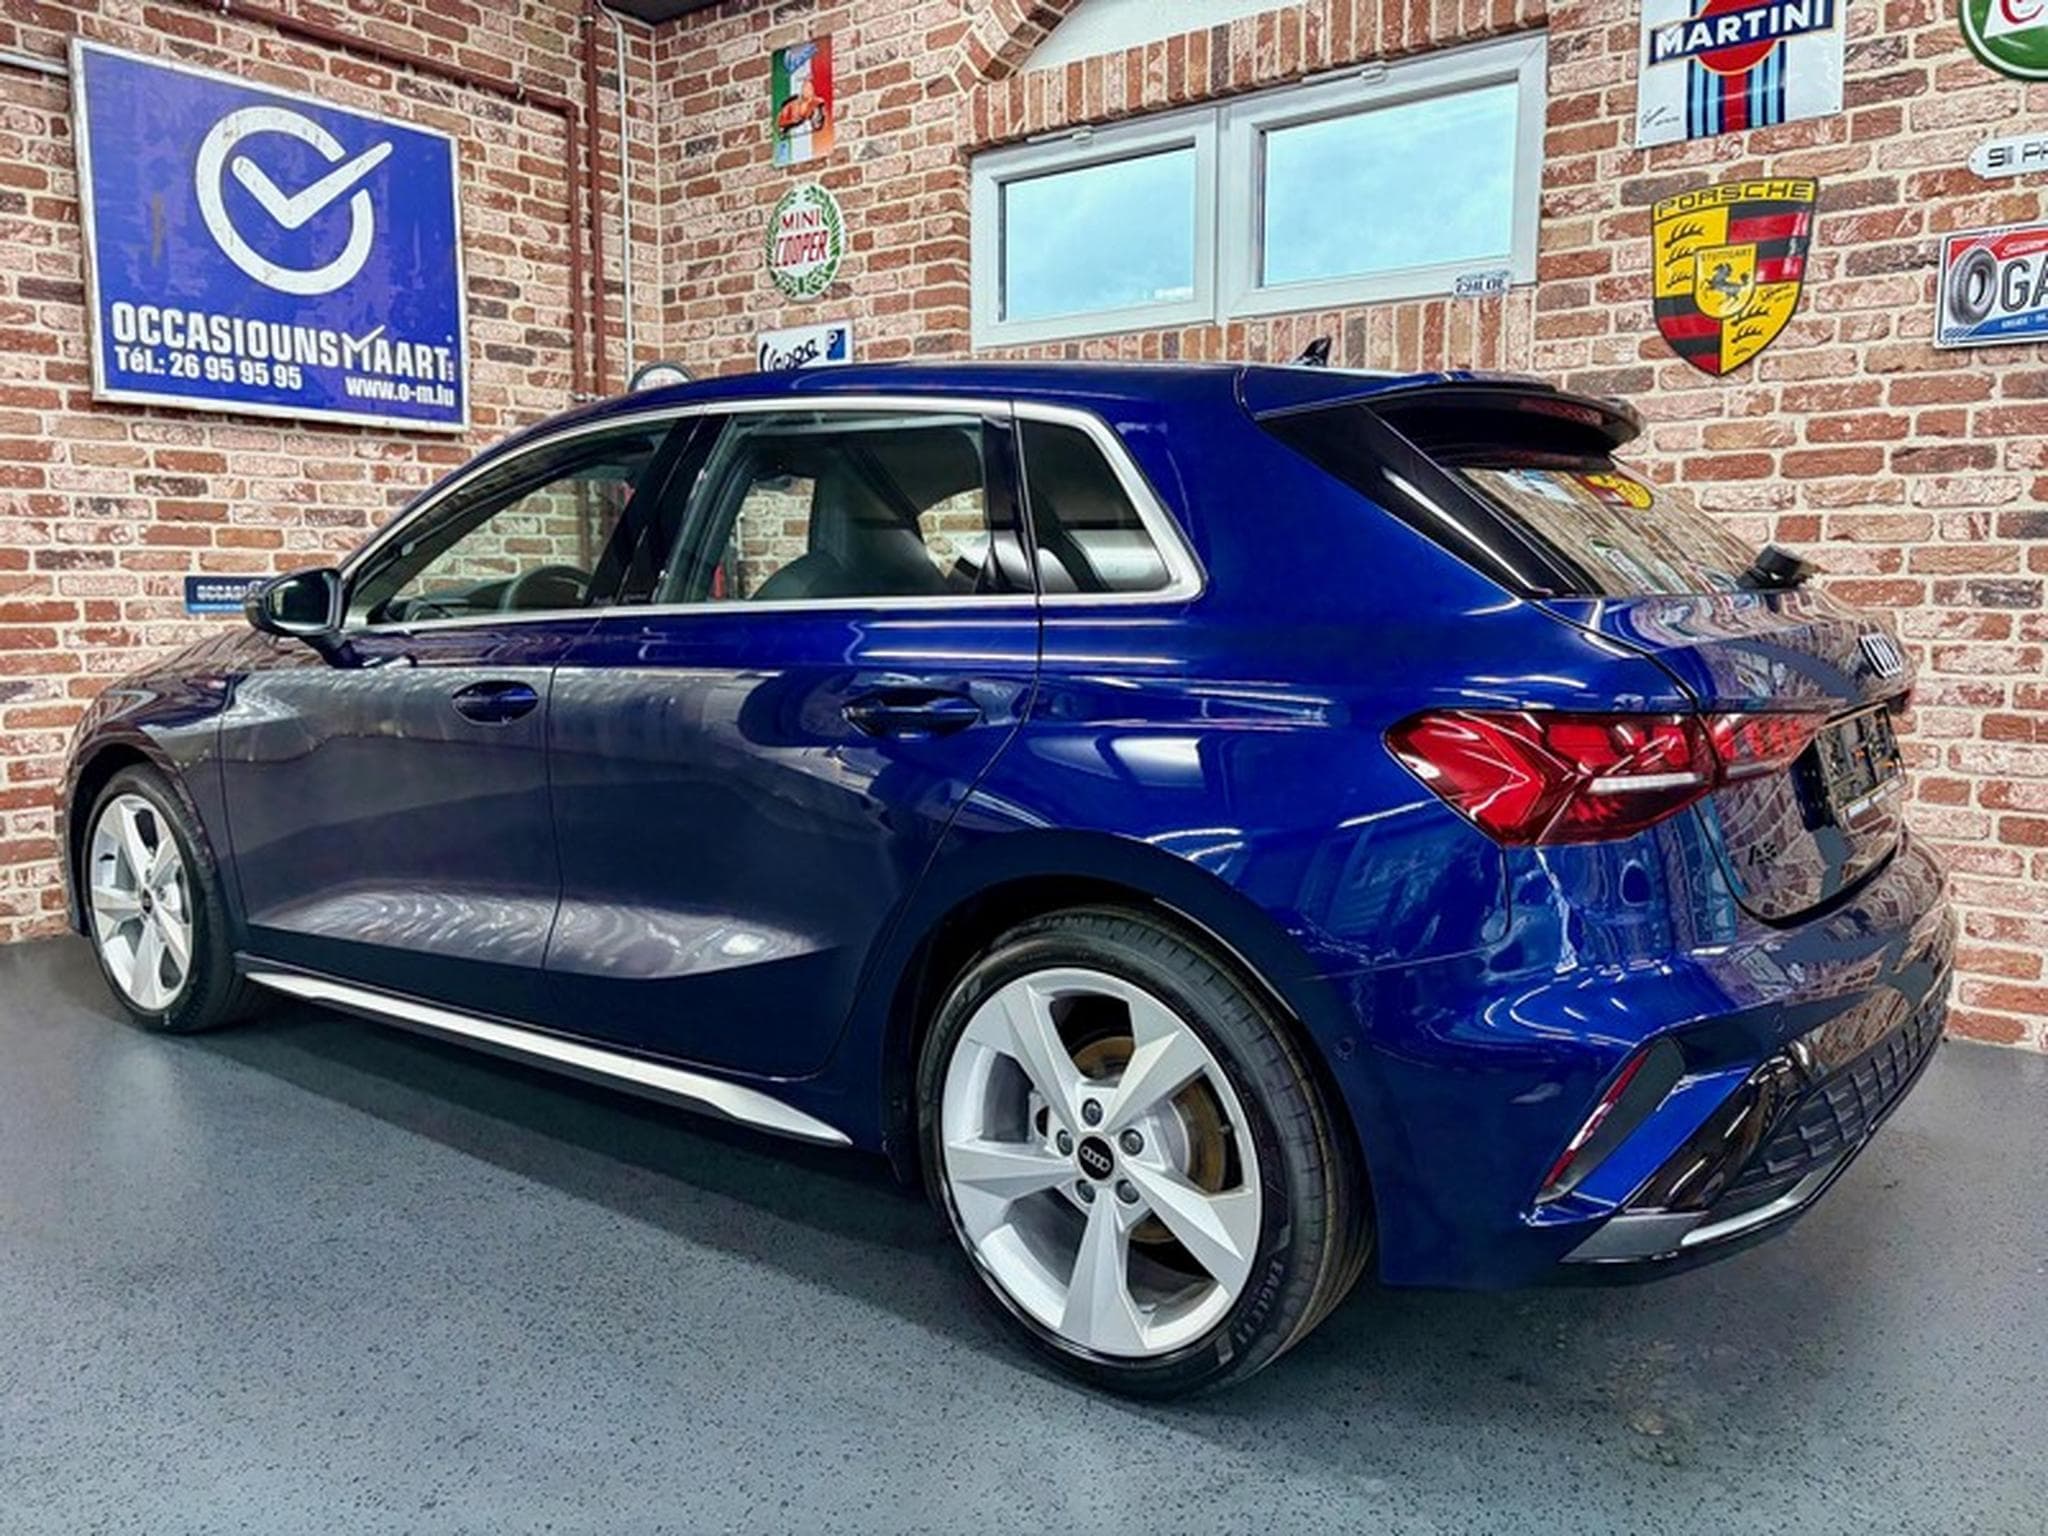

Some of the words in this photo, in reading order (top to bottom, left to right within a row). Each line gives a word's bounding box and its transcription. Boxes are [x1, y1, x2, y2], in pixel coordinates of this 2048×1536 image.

[1656, 0, 1826, 59] MARTINI
[1657, 183, 1811, 218] PORSCHE
[782, 209, 820, 231] MINI
[774, 230, 828, 268] COOPER
[169, 352, 200, 379] 26
[204, 356, 235, 383] 95
[239, 360, 270, 387] 95
[273, 364, 303, 391] 95
[345, 376, 455, 407] www.o-m.lu
